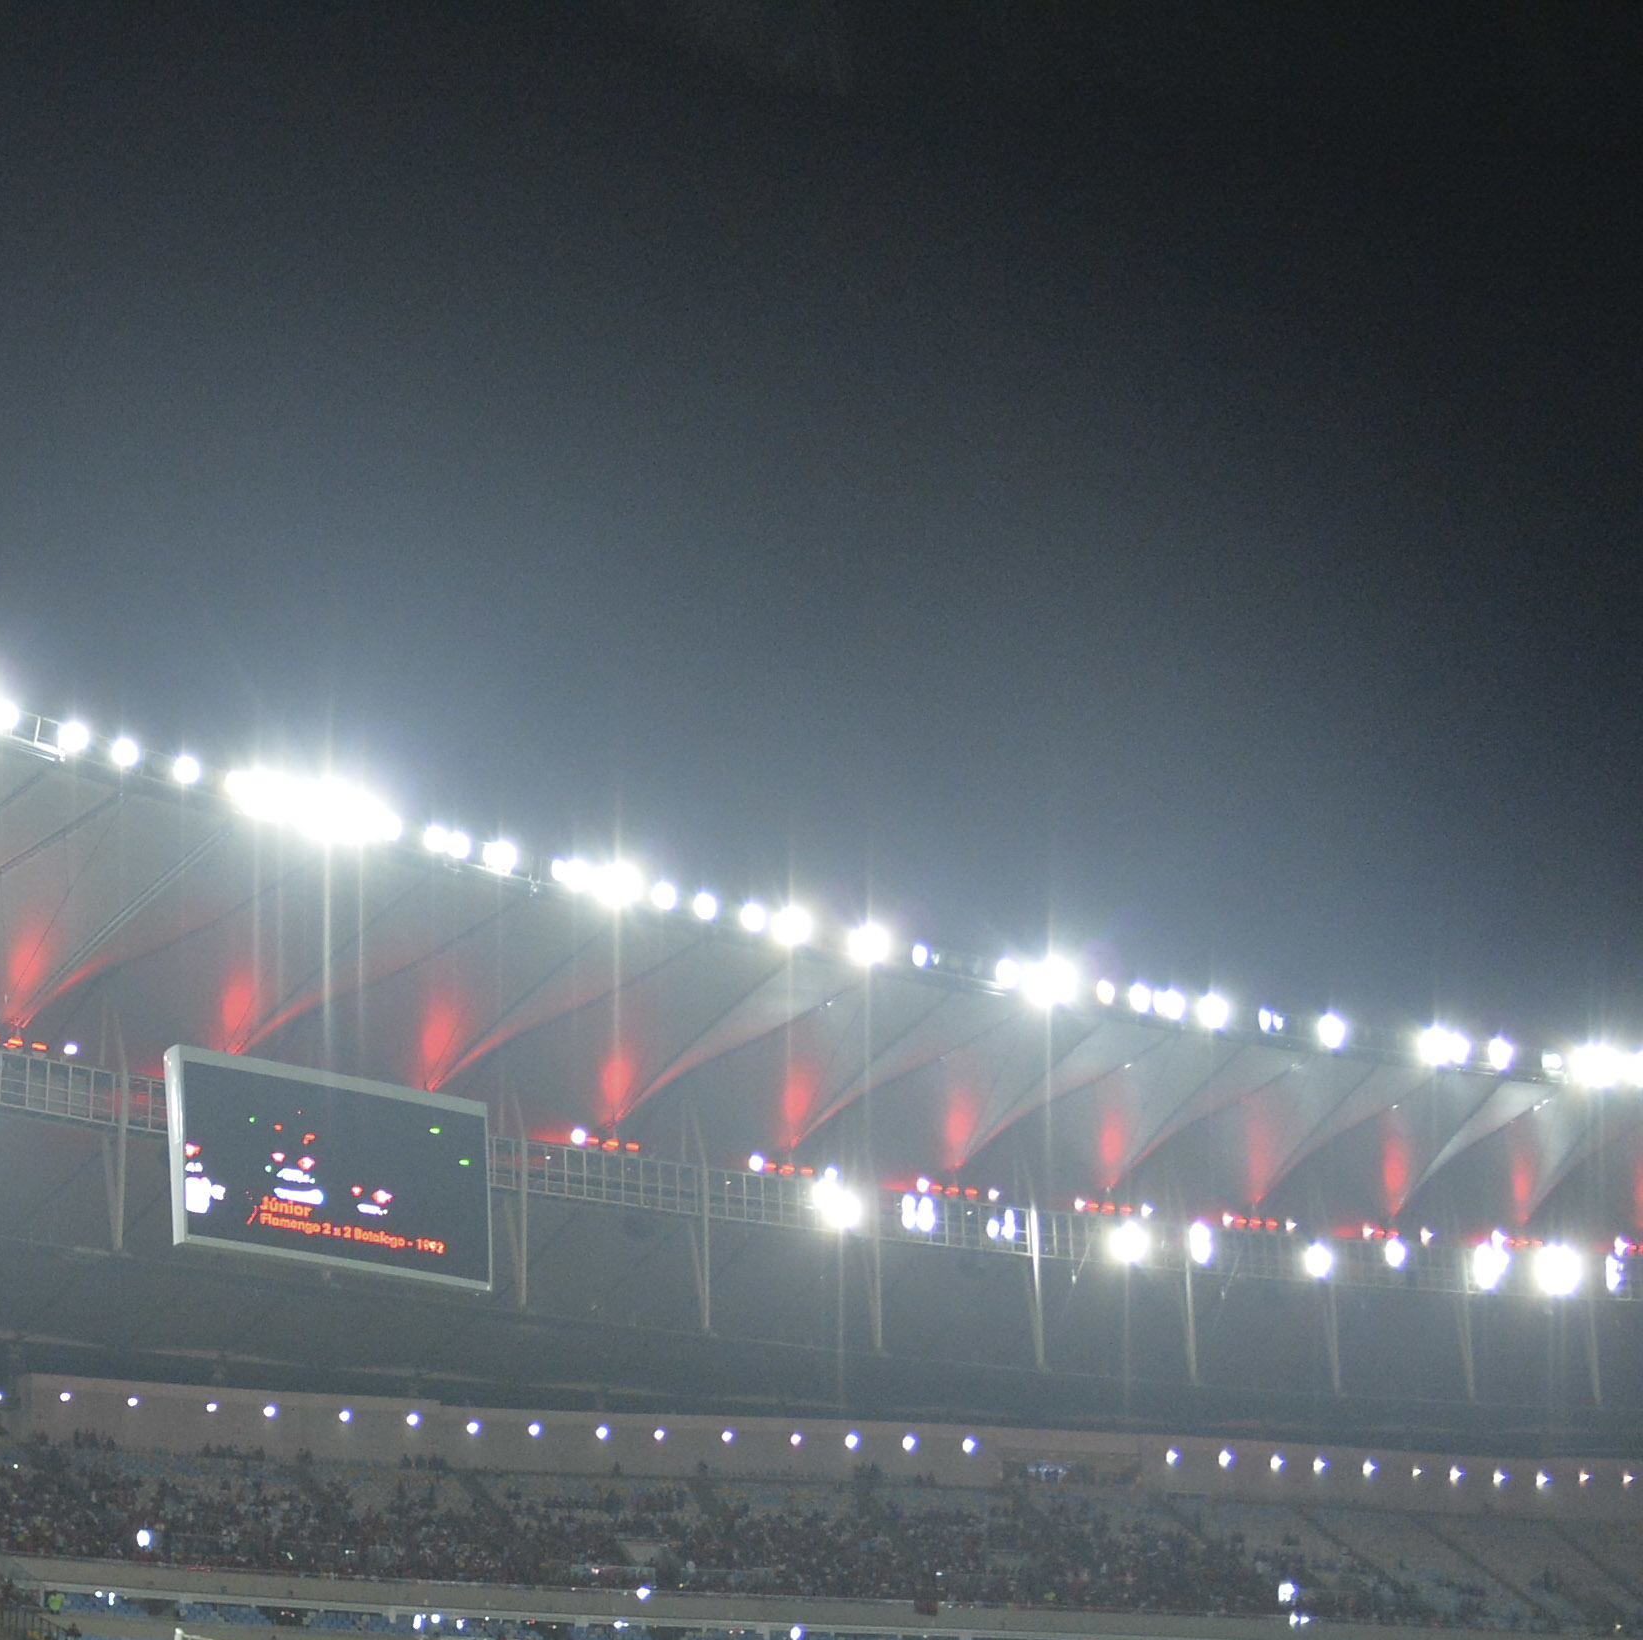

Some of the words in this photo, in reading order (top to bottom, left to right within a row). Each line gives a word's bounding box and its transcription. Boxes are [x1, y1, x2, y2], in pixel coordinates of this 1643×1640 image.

[260, 1196, 313, 1218] Júnior
[260, 1213, 321, 1235] Flamengo
[323, 1223, 331, 1235] 2
[344, 1225, 352, 1239] 2
